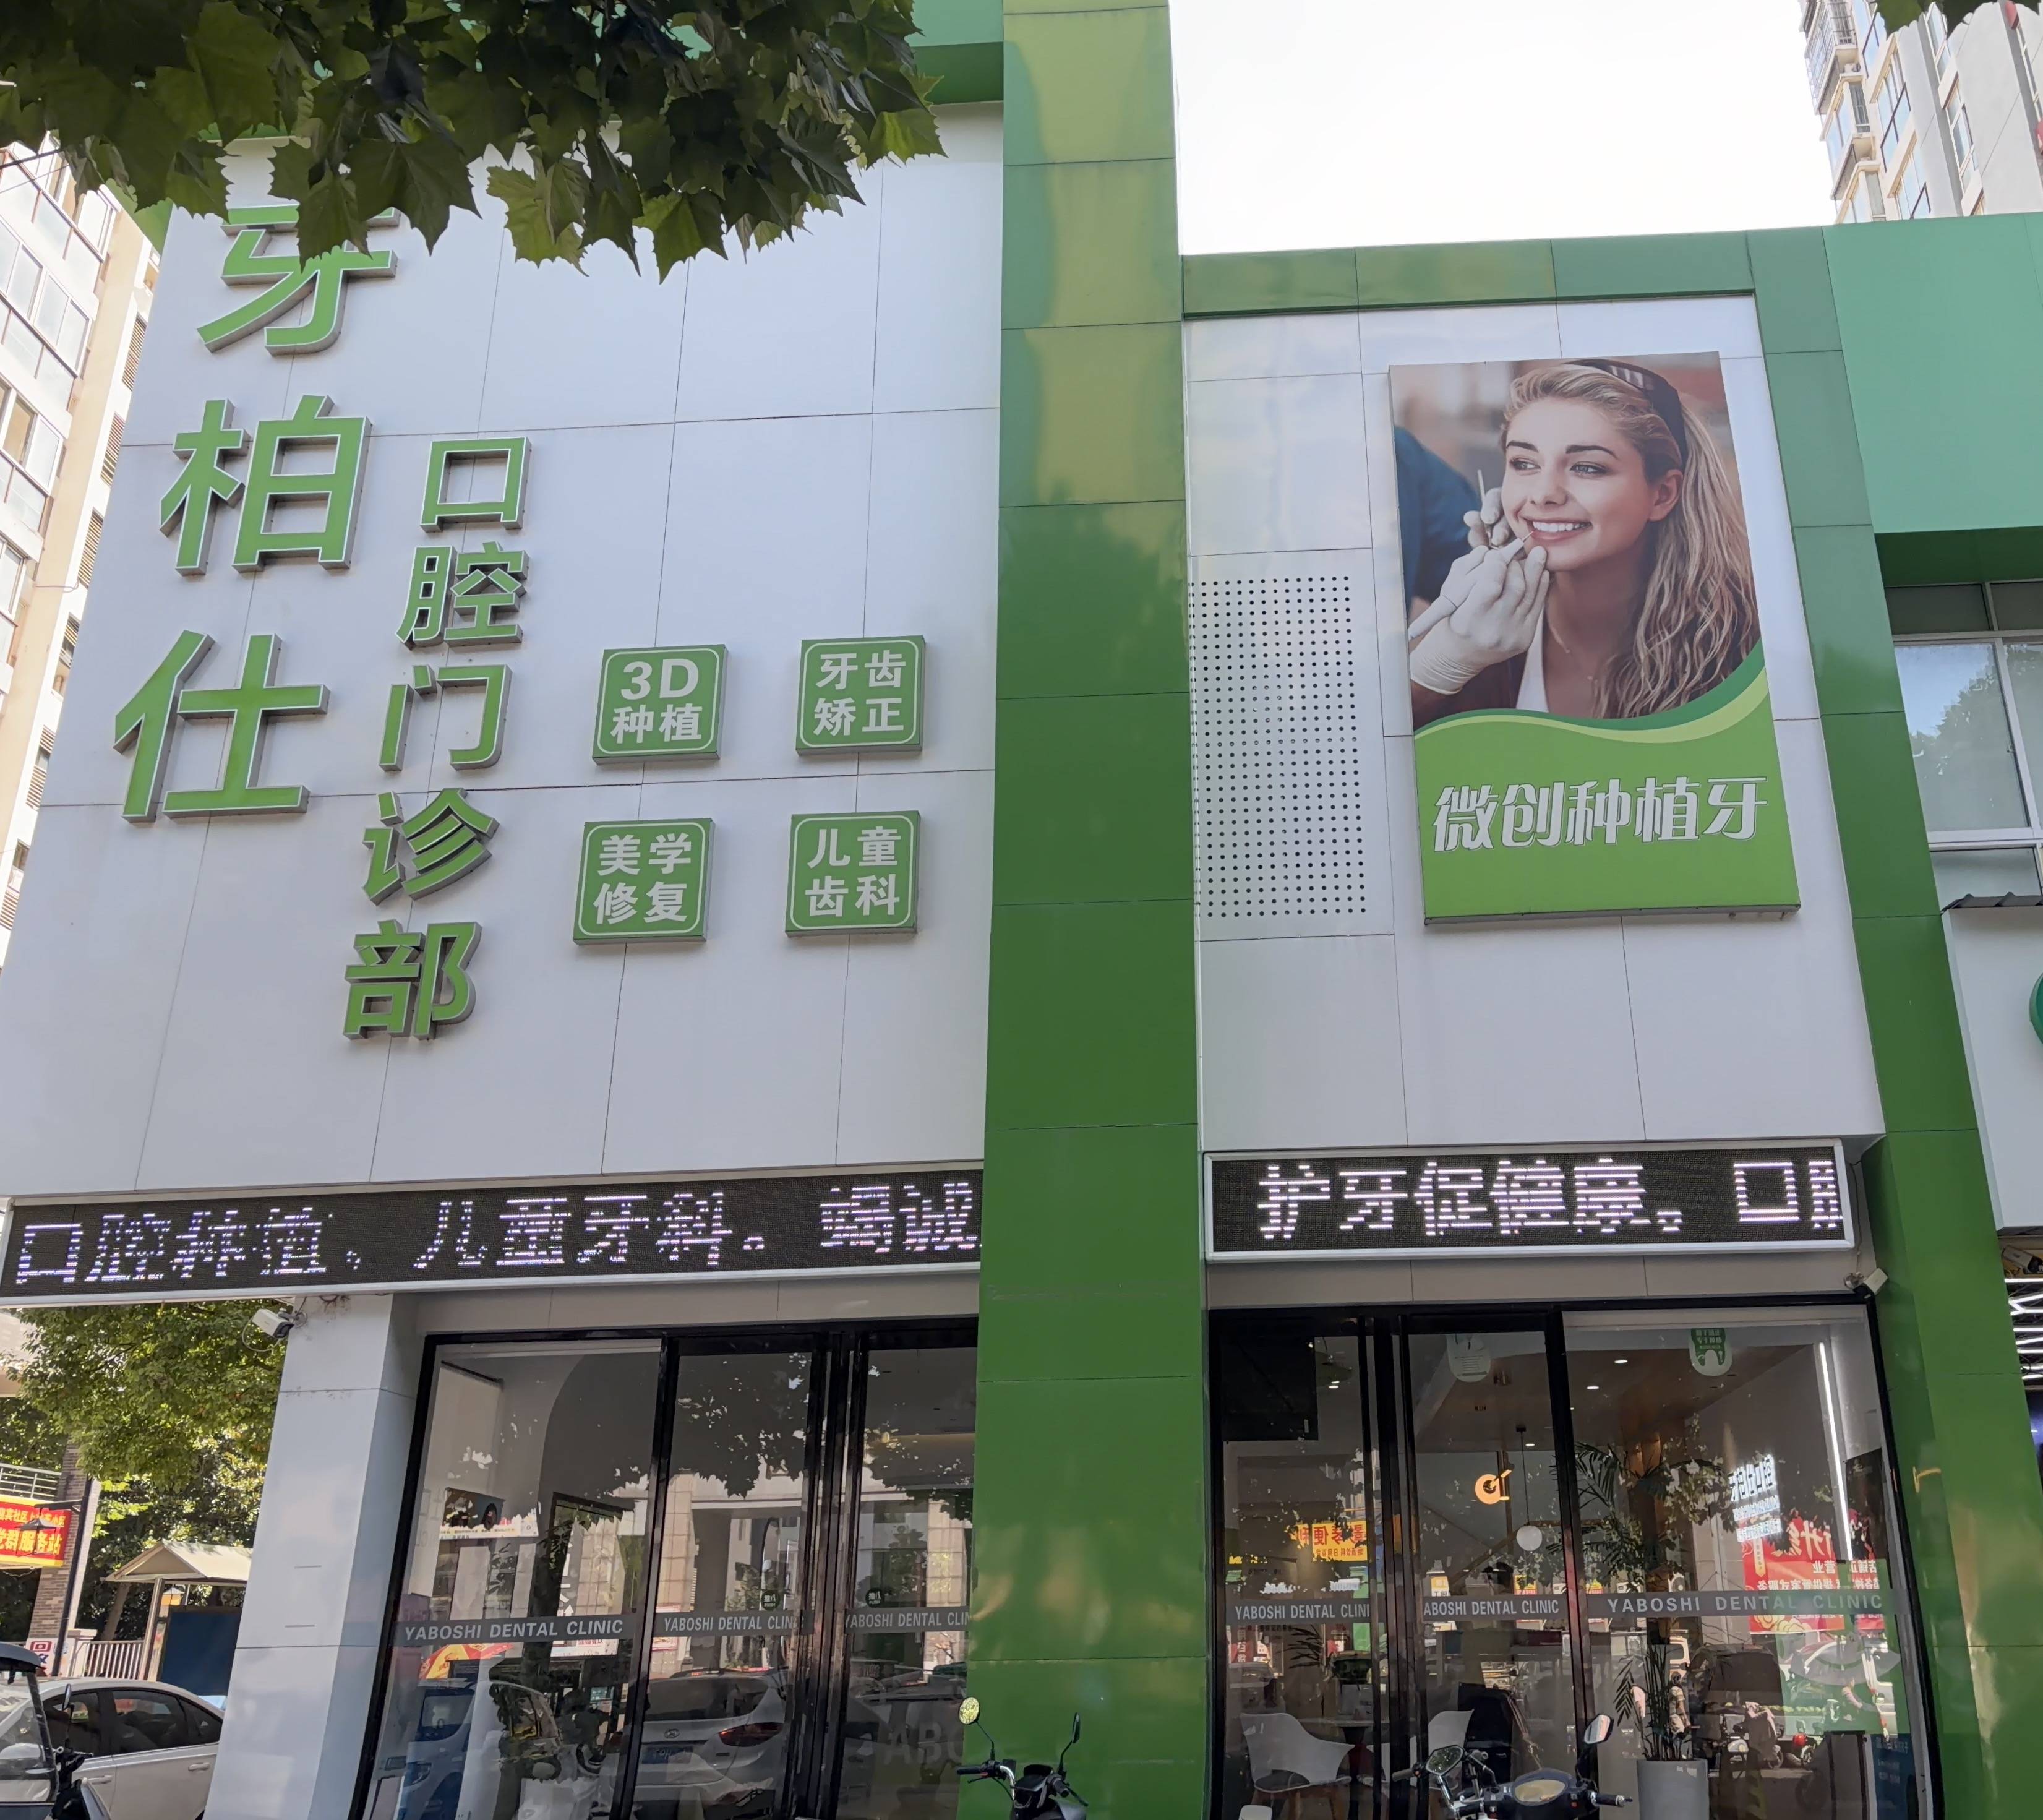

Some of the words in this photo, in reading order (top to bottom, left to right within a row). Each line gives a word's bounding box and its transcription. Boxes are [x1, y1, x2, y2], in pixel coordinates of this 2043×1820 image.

[620, 658, 700, 700] 3D
[815, 650, 906, 690] 牙齿
[610, 703, 703, 744] 种植
[813, 697, 904, 736] 矫正
[342, 436, 532, 1041] 口腔门诊部
[1433, 776, 1768, 852] 微创种植牙
[597, 832, 692, 876] 美学
[807, 825, 901, 869] 儿童
[593, 881, 688, 925] 修复
[805, 873, 900, 917] 齿科
[664, 1616, 714, 1632] YABOSHI
[718, 1615, 763, 1631] DENTAL
[898, 1612, 942, 1627] DENTAL
[1235, 1605, 1286, 1621] YABOSHI
[1290, 1604, 1336, 1619] DENTAL
[1471, 1600, 1517, 1615] DENTAL
[1522, 1599, 1559, 1614] CLINIC
[1608, 1597, 1701, 1613] YABOSHI
[1716, 1595, 1797, 1612] DENTAL
[1812, 1594, 1883, 1610] CLINIC
[405, 1625, 482, 1641] YABOSHI
[489, 1621, 558, 1638] DENTAL
[566, 1619, 623, 1635] CLINIC
